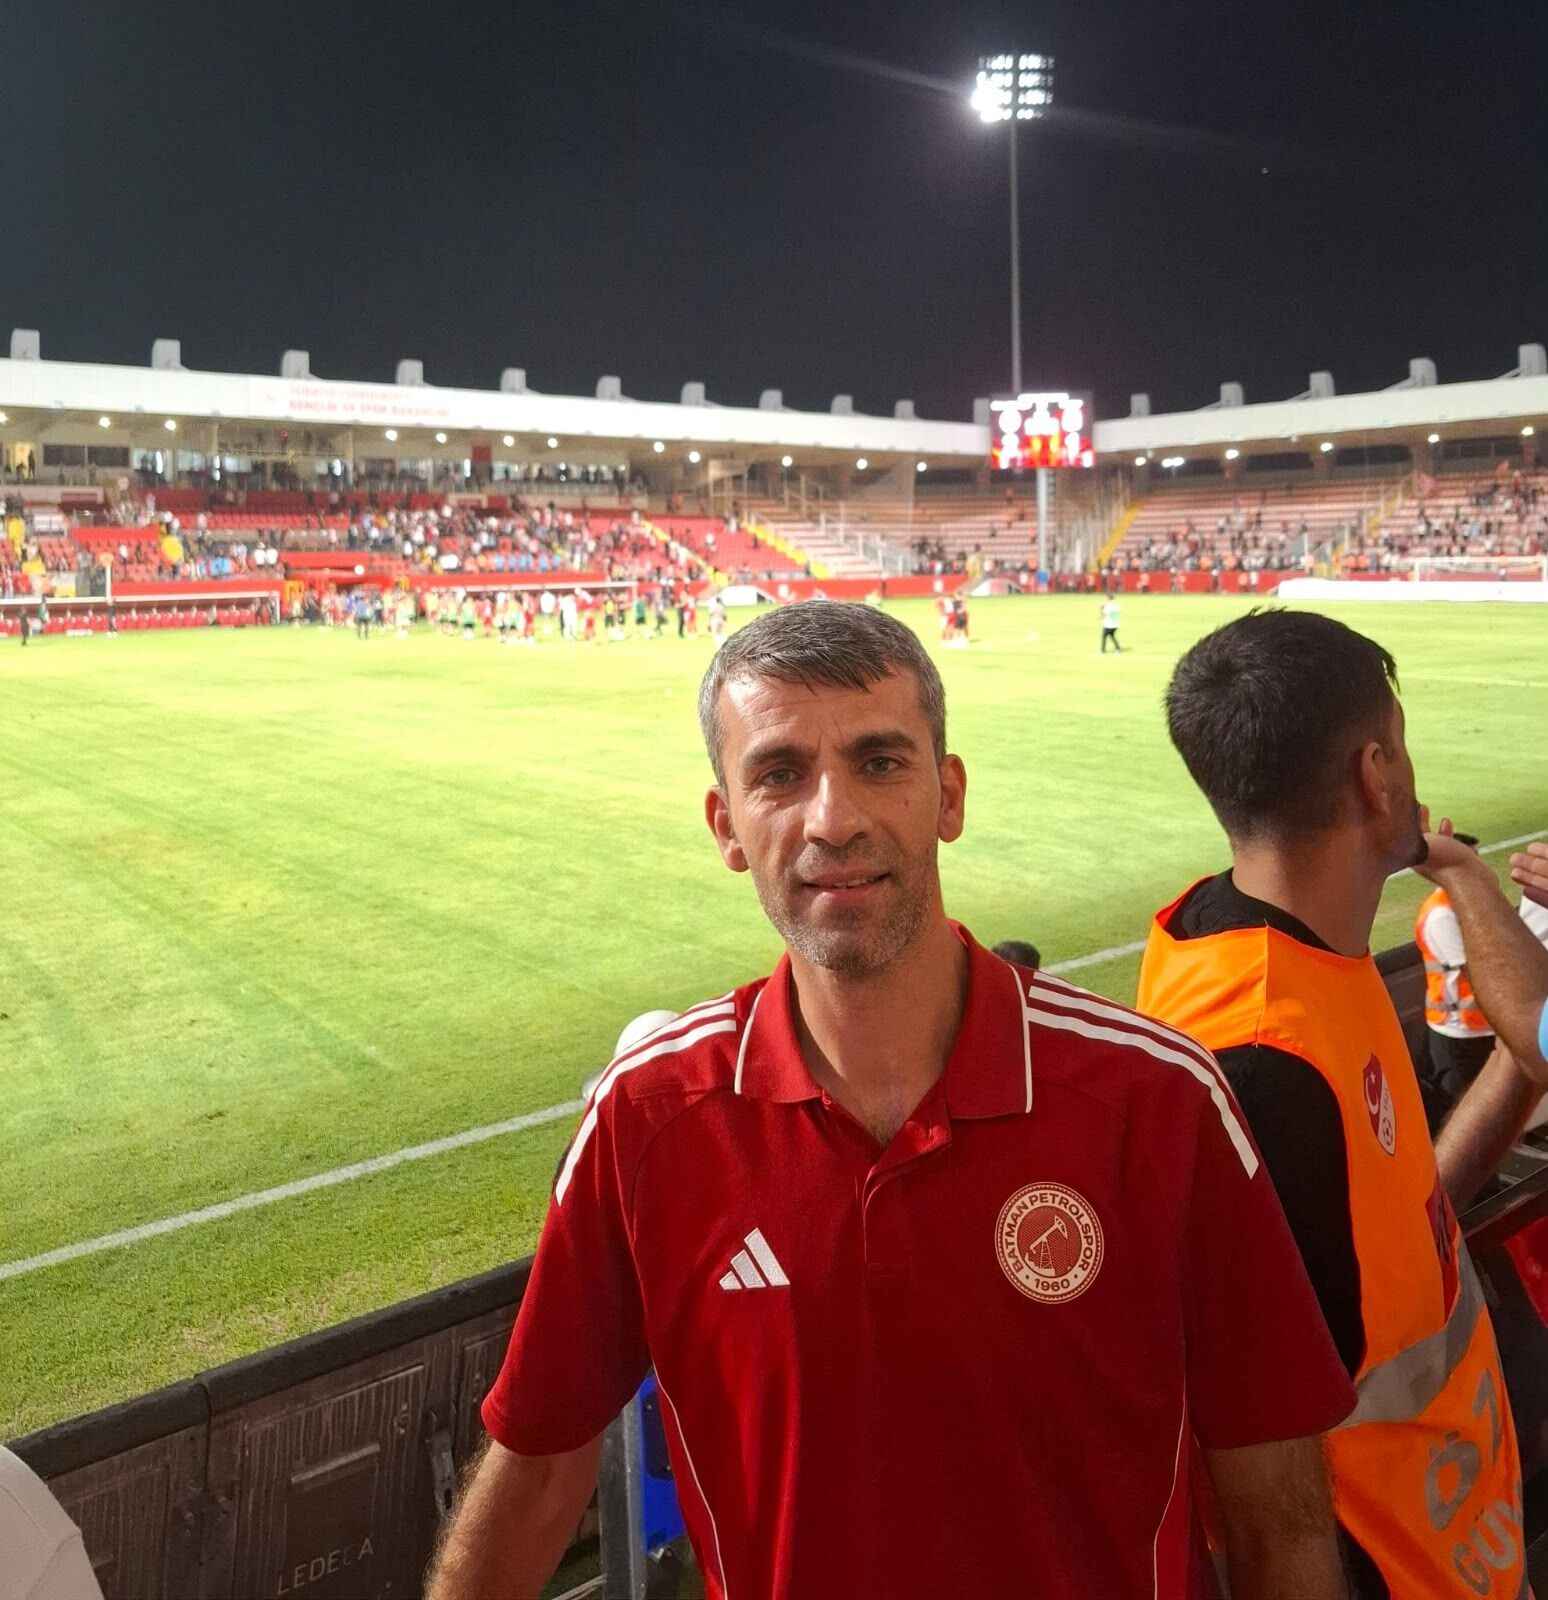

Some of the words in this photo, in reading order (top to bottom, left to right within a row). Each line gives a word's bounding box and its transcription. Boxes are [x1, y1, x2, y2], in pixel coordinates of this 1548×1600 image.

[1005, 1200, 1029, 1274] BATMAN
[1029, 1193, 1094, 1272] PETROLSPOR
[1034, 1279, 1070, 1292] 1960
